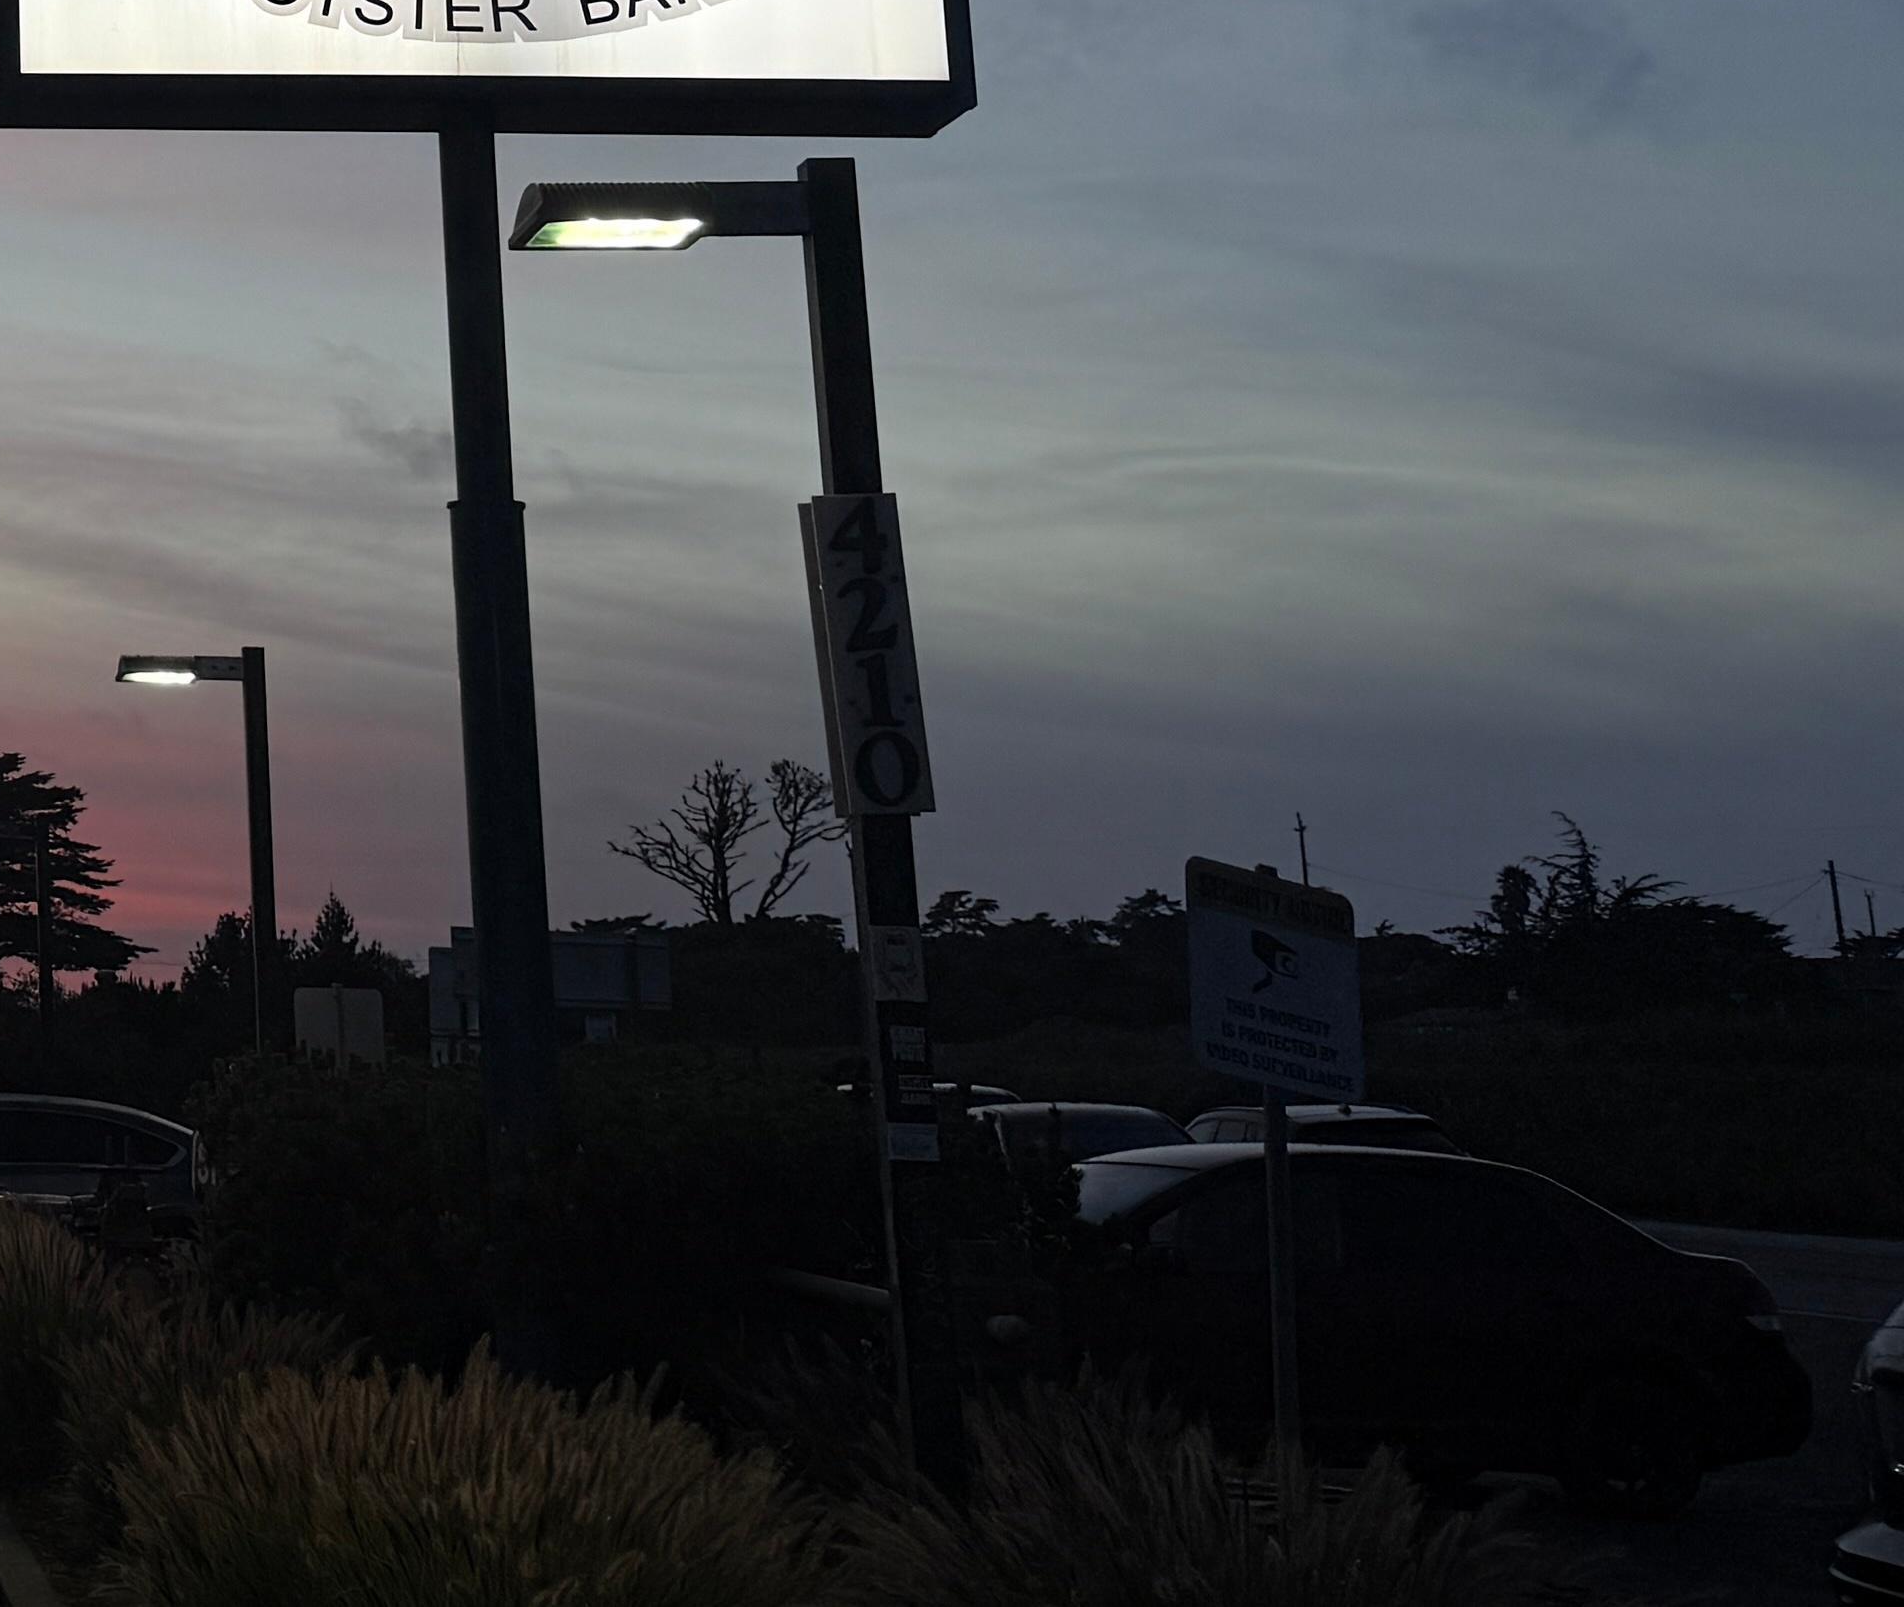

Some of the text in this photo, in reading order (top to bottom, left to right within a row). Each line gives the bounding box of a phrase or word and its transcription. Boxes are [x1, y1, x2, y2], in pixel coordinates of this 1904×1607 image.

[827, 495, 920, 808] 4210
[1222, 1019, 1339, 1063] IS PROTECTED BY
[1225, 996, 1330, 1038] THIS PROPERTY
[1206, 1041, 1355, 1093] VIDEO SURVEILLANCE
